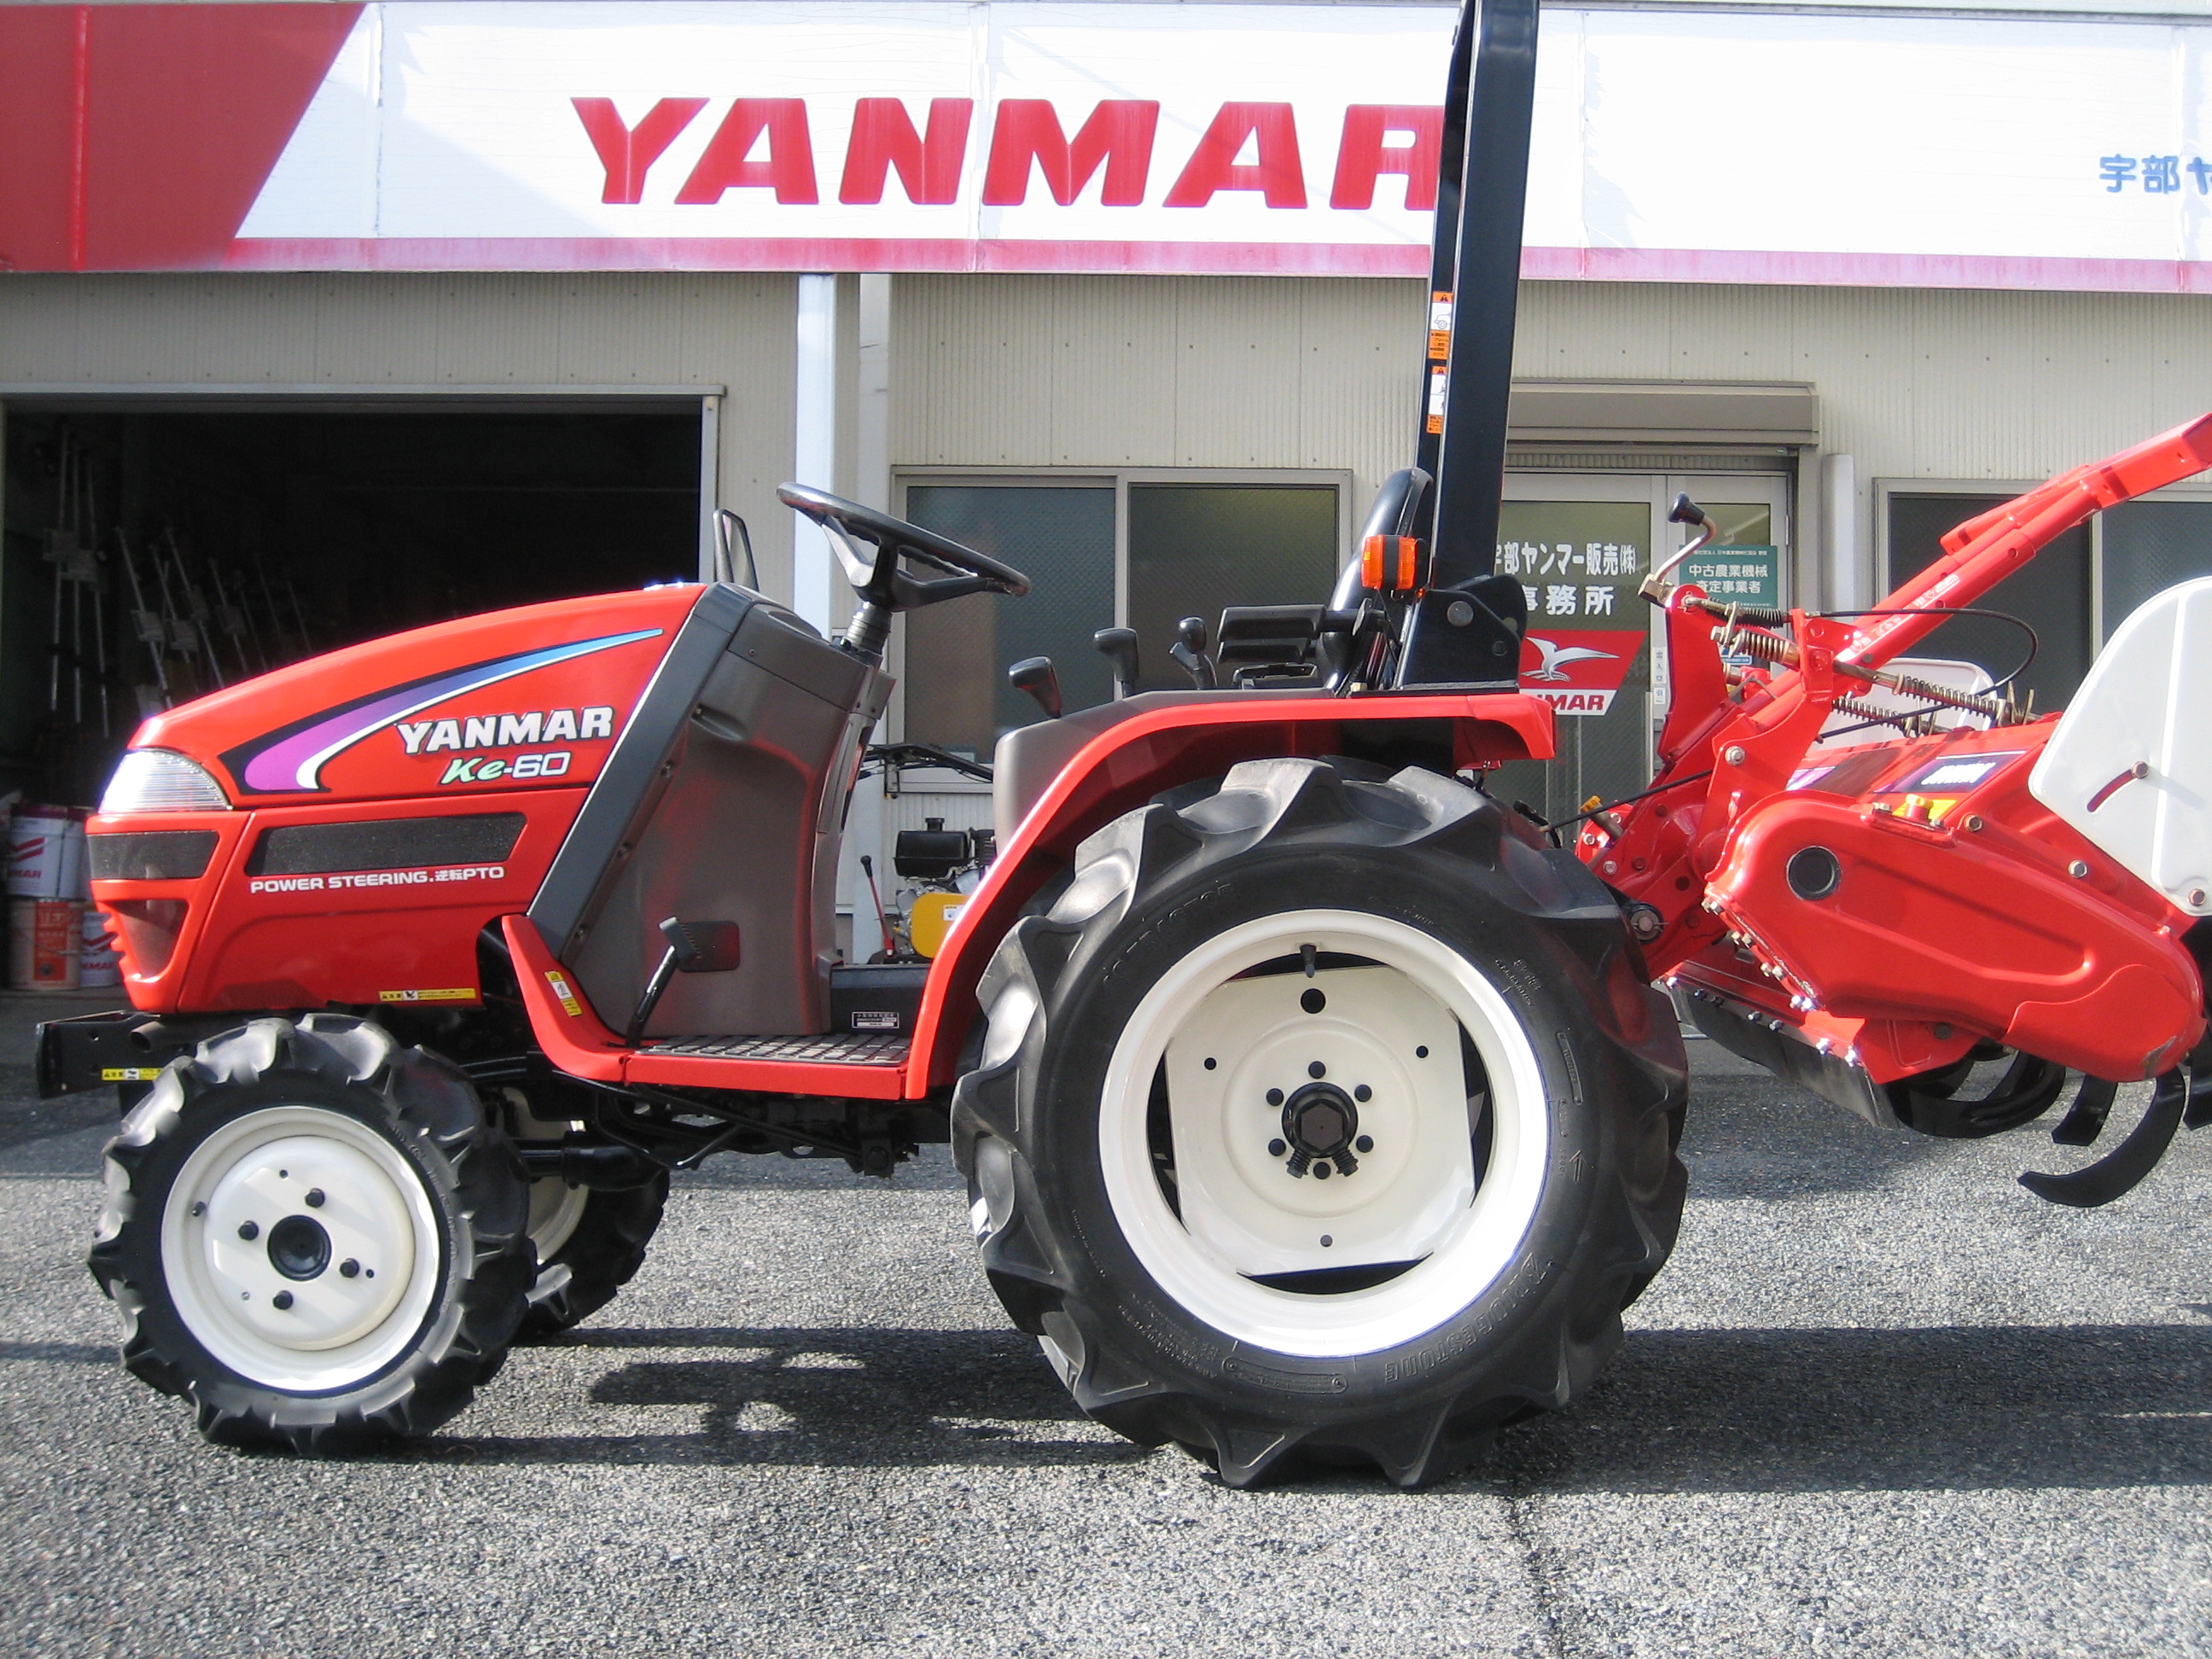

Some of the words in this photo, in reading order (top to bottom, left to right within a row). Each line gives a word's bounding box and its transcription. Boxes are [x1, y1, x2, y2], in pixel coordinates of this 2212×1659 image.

[570, 97, 1444, 211] YANMAR
[1689, 564, 1768, 578] 中古農業機械
[1537, 694, 1605, 711] MAR
[395, 706, 614, 755] YANMAR
[439, 751, 573, 785] Ke-60
[250, 876, 324, 894] POWER
